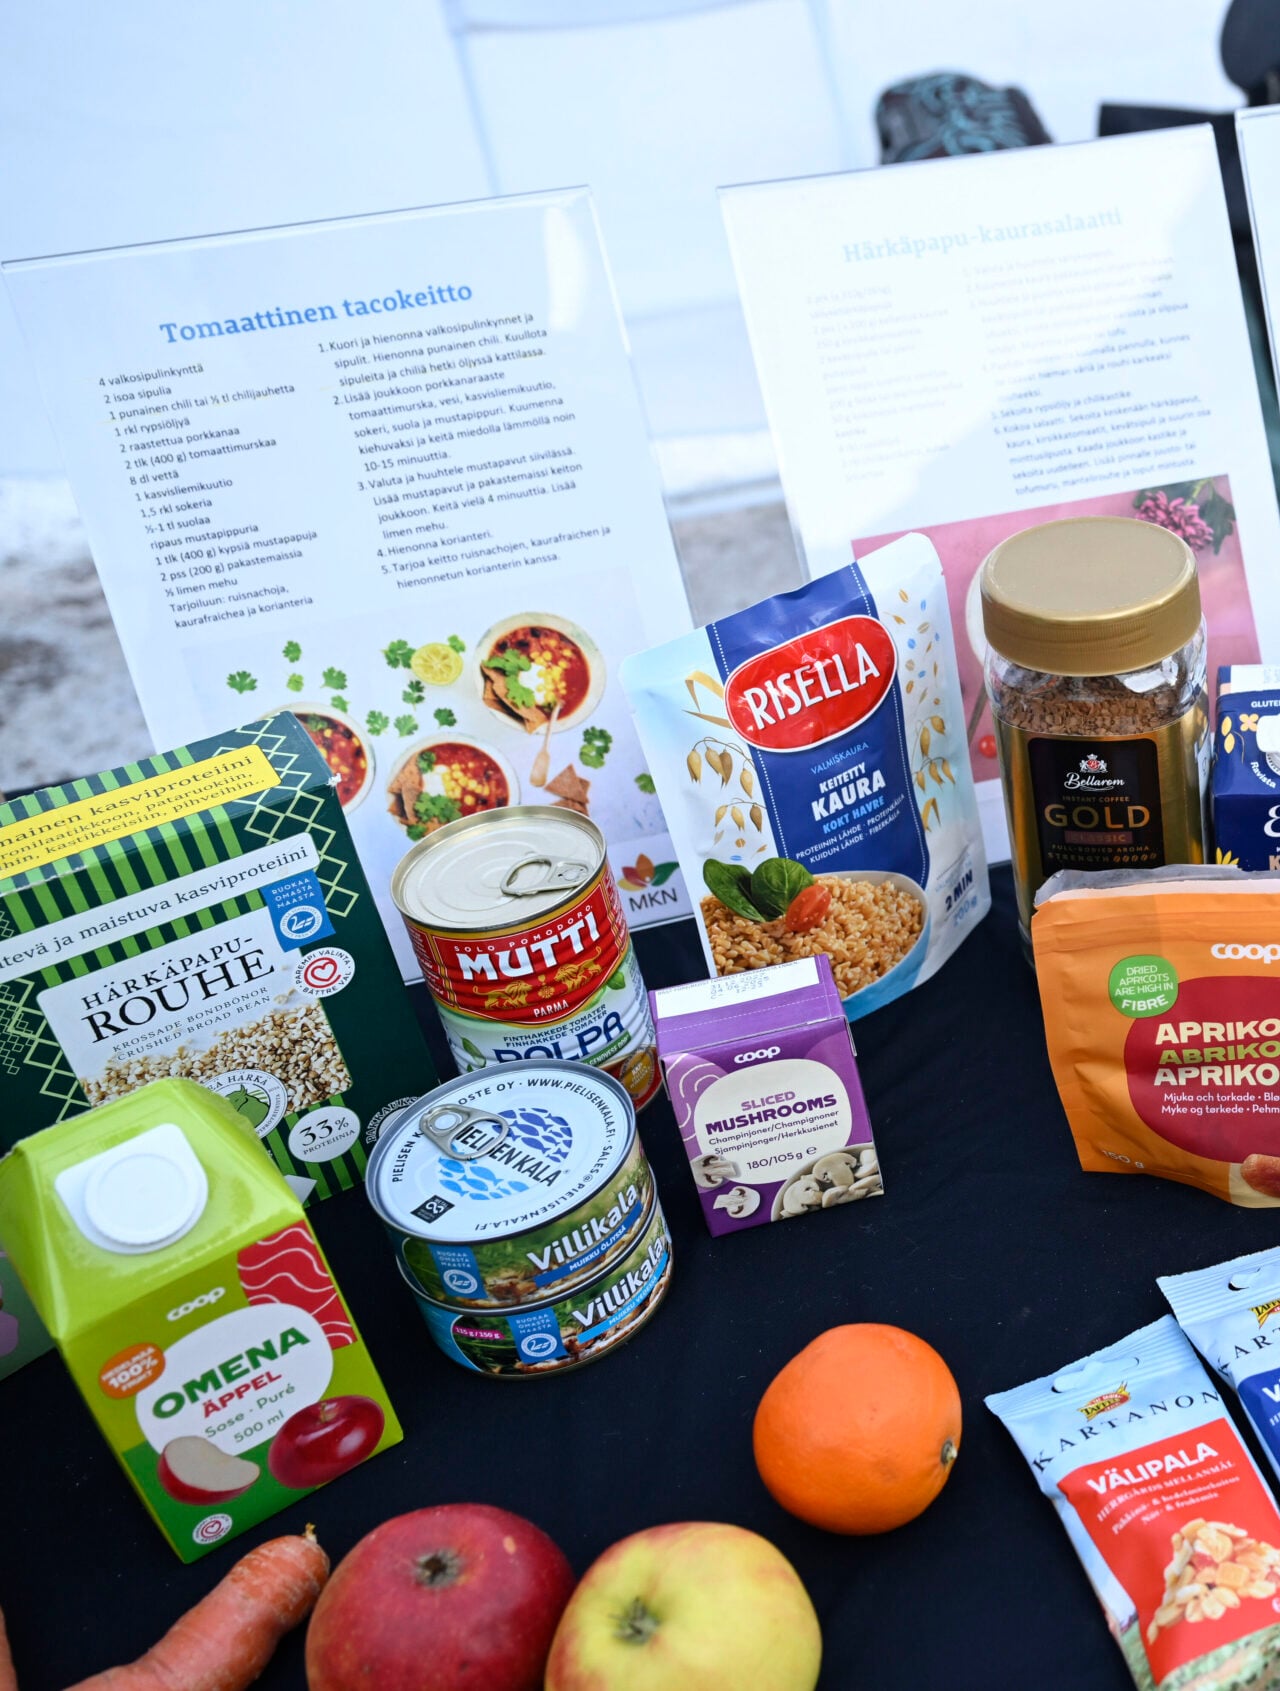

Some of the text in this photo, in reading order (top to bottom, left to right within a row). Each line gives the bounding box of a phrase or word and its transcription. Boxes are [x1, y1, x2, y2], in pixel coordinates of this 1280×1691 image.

[159, 284, 472, 343] Tomaattinen tacokeitto
[373, 328, 547, 363] Hienonna punainen Kuullota
[108, 362, 204, 387] valkosipulinkynttä
[129, 427, 240, 453] raastettua porkkanaa
[189, 438, 277, 459] tomaattimurskaa
[144, 478, 233, 502] kasvisliemikuutio
[150, 523, 259, 552] ripaus mustapippuria
[397, 559, 522, 589] hienonnetun korianterin
[174, 595, 313, 629] kaurafraichea korianteria
[742, 642, 881, 731] RISELLA
[810, 742, 869, 775] VALMISKAURA
[1250, 760, 1277, 789] Ravista
[90, 755, 255, 817] kasviproteiini
[146, 771, 253, 813] pataruokiin,
[811, 769, 886, 822] KAURA
[819, 762, 867, 794] KEITETTY
[1064, 771, 1126, 791] Bellarom
[822, 795, 885, 834] KOKT HAVRE
[1044, 804, 1151, 829] GOLD
[1099, 795, 1131, 804] COFFEE
[46, 811, 168, 854] kastikkeisiin,
[796, 821, 861, 860] PROTEIININ LÄHDE
[809, 832, 865, 864] KUIDUN LÄHDE
[54, 845, 310, 954] ja maistuva kasviproteiini
[272, 876, 311, 895] RUOKAA
[274, 884, 314, 902] OMASTA
[277, 890, 316, 909] MAASTA
[628, 888, 679, 912] MKN
[453, 944, 496, 953] SOLO
[455, 910, 601, 981] MUTTI
[81, 936, 253, 1011] HÄRKÄPAPU-
[1119, 973, 1170, 987] APRICOTS
[1126, 965, 1158, 976] DRIED
[81, 948, 276, 1044] ROUHE
[1114, 984, 1162, 997] ARE HIGH
[1121, 994, 1169, 1011] FIBRE
[112, 985, 269, 1053] KROSSADE BONDBÖNOR
[503, 1003, 607, 1043] FINTHAKKEDE TOMATER
[532, 999, 570, 1018] PARMA
[117, 994, 271, 1062] CRUSHED BROAD BEAN
[505, 1009, 608, 1048] FINHAKKEDE TOMATER
[733, 1045, 781, 1064] coop
[496, 1080, 516, 1093] OY
[741, 1091, 796, 1112] SLICED
[1164, 1092, 1195, 1105] Mjuka
[1196, 1092, 1215, 1102] och
[1216, 1092, 1256, 1102] torkade
[526, 1078, 616, 1138] WWW.PIELISENKALA.FI
[705, 1094, 837, 1136] MUSHROOMS
[1161, 1105, 1188, 1117] Myke
[1189, 1107, 1204, 1117] og
[1205, 1105, 1245, 1115] tørkede
[298, 1117, 333, 1148] 33
[303, 1128, 356, 1156] PROTEIINIA
[708, 1110, 840, 1146] Champinjoner/Champignoner
[714, 1120, 839, 1156] Sjampinjonger/Herkkusienet
[392, 1140, 416, 1183] PIELISEN
[746, 1152, 795, 1171] 180/105
[474, 1145, 613, 1231] SALES@PIELISENKALA.FI
[526, 1184, 639, 1271] Villikala
[569, 1223, 627, 1272] MUIKKU ÖLJYSSÄ
[571, 1237, 664, 1328] Villikala
[166, 1286, 226, 1322] coop
[108, 1356, 159, 1390] 100%
[151, 1326, 312, 1420] OMENA
[202, 1370, 283, 1419] ÄPPEL
[204, 1381, 296, 1439] Sose Puré
[233, 1409, 285, 1444] 500 ml
[1031, 1389, 1220, 1474] KARTANON
[1086, 1441, 1219, 1495] VÄLIPALA
[1096, 1459, 1236, 1523] HERRGÅRDS MELLANMÅL
